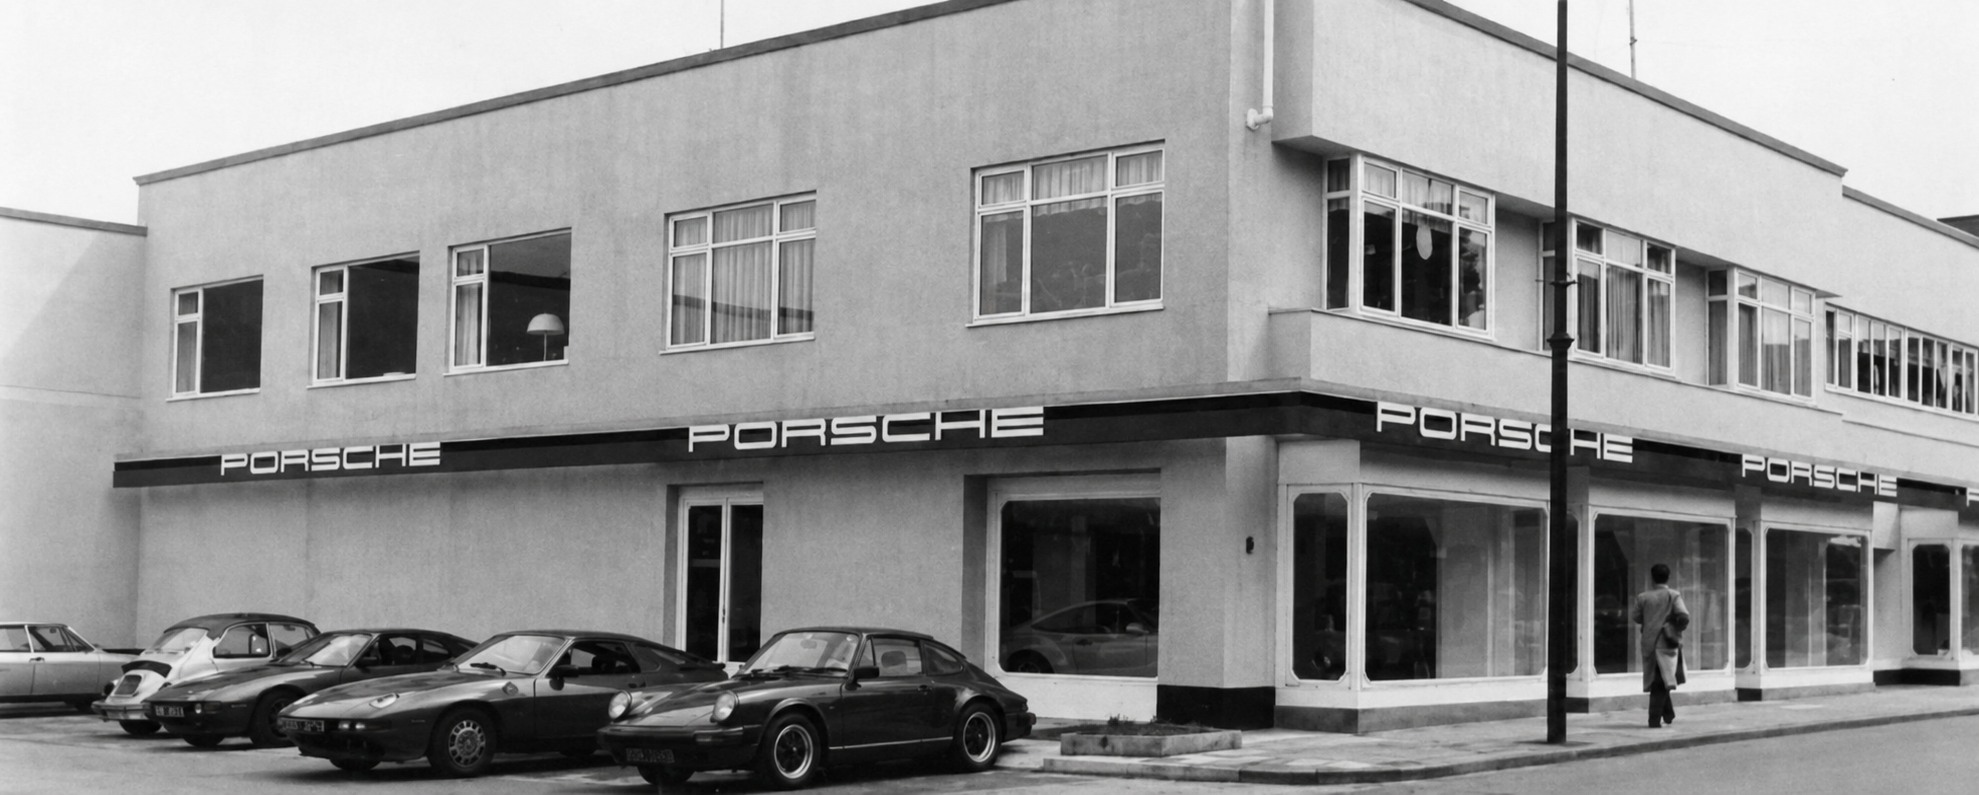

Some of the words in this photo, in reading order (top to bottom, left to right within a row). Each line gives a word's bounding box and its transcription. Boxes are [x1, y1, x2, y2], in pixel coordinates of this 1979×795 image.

[688, 406, 1044, 452] PORSCHE
[1376, 401, 1633, 463] PORSCHE
[220, 441, 440, 476] PORSCHE
[1742, 454, 1897, 497] PORSCHE
